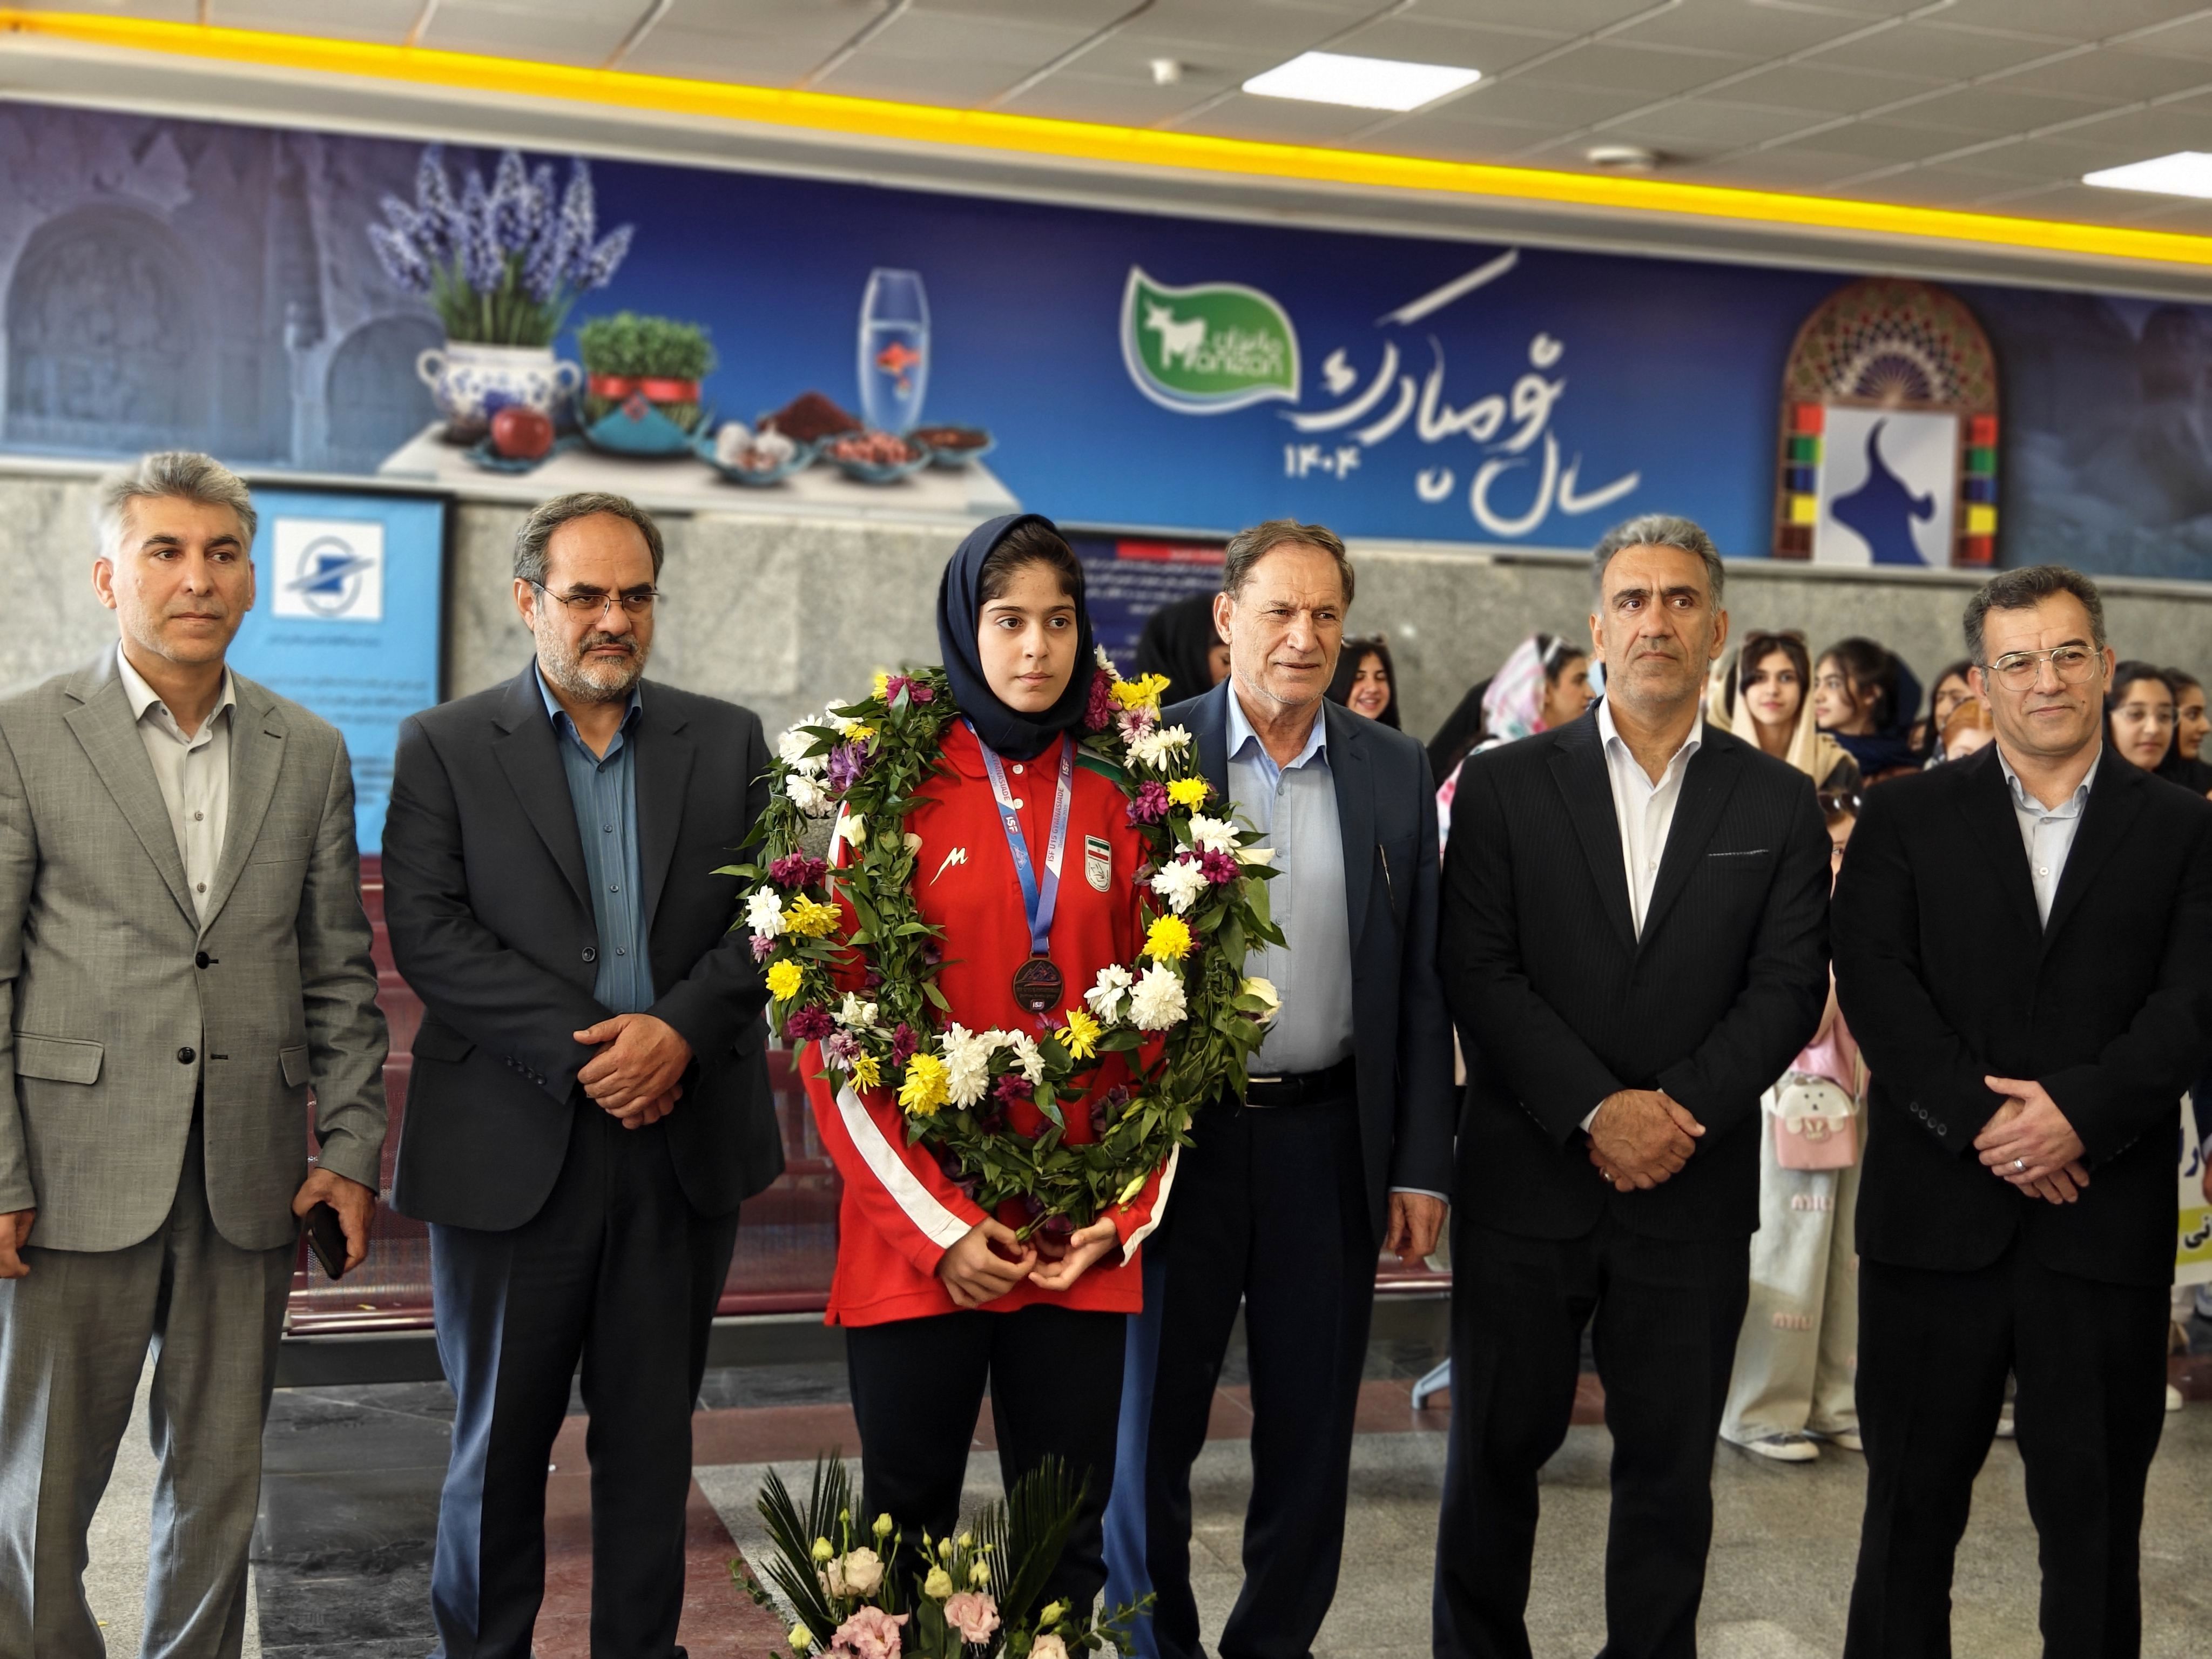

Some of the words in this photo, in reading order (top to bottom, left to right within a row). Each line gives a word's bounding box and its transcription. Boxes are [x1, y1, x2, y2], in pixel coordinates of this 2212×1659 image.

[1469, 431, 1641, 536] سال
[991, 753, 1010, 801] GYMNASIADE
[1062, 758, 1070, 776] ISF
[1005, 816, 1018, 833] ISF
[1052, 786, 1064, 834] GYMNASIADE
